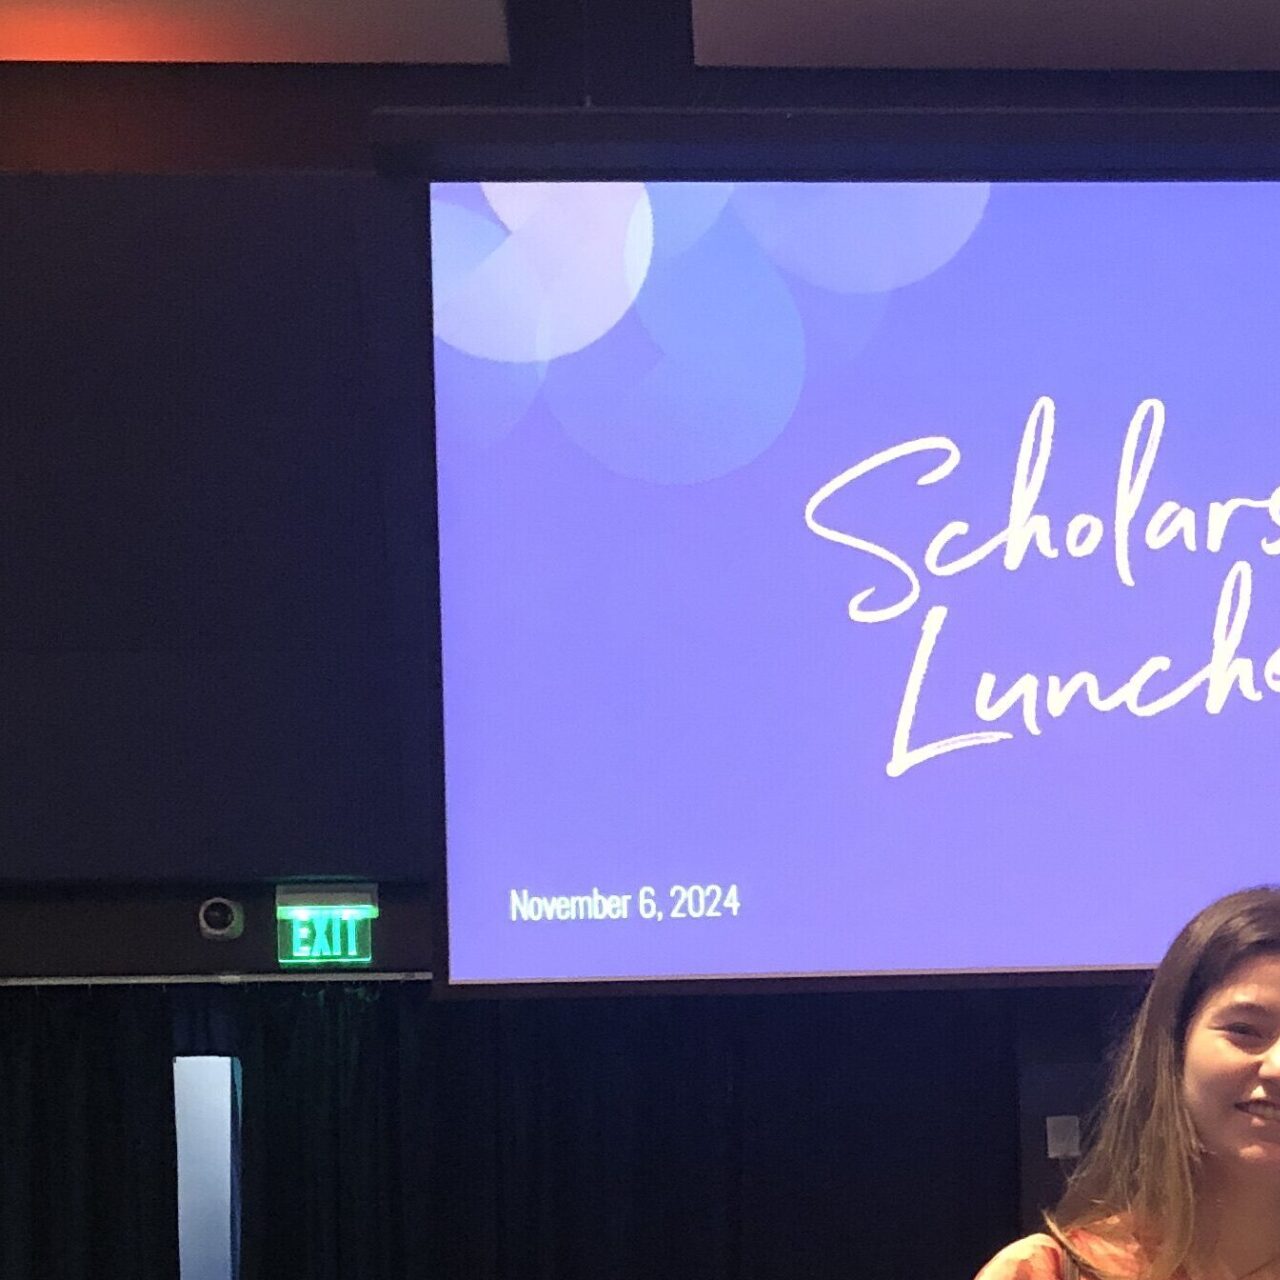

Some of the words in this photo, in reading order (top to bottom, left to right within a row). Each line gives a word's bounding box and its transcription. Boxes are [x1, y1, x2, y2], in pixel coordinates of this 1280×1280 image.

[509, 887, 632, 922] November
[638, 886, 664, 922] 6,
[669, 884, 741, 918] 2024
[292, 915, 359, 958] EXIT
